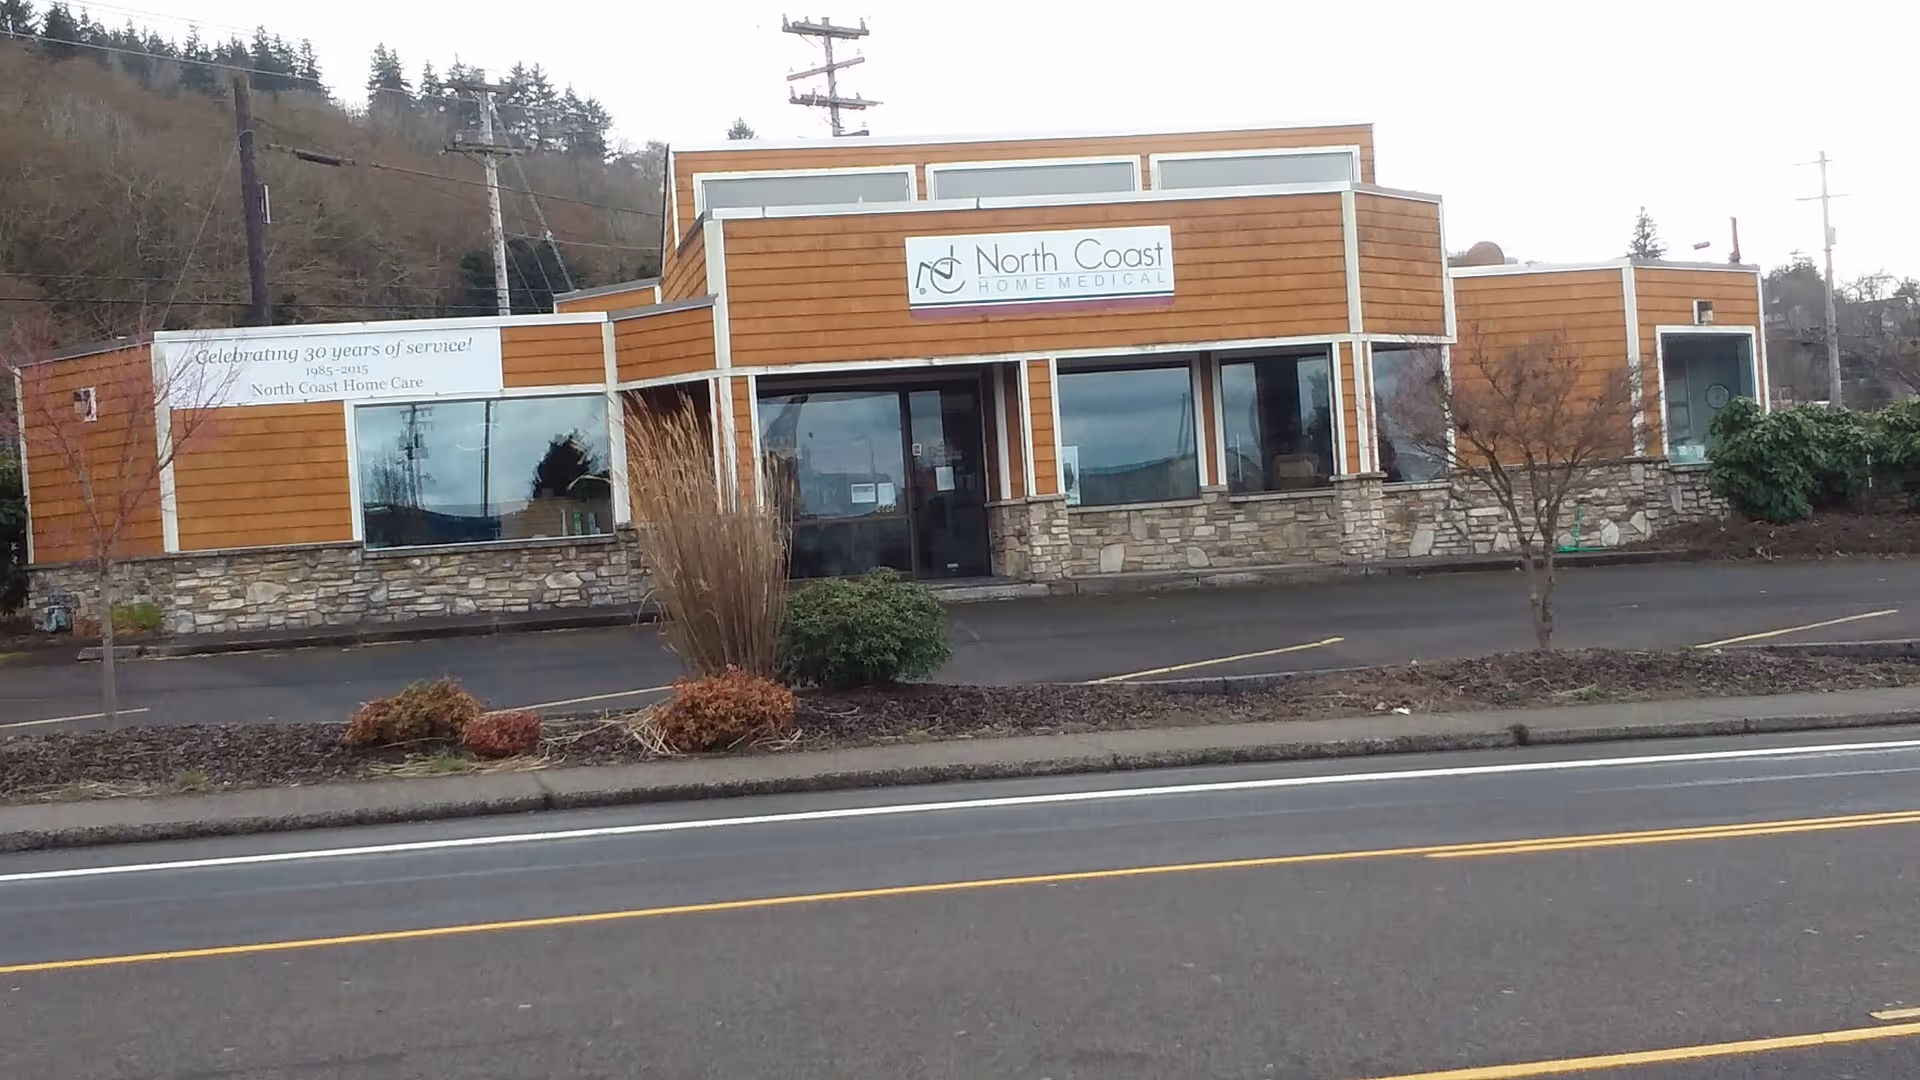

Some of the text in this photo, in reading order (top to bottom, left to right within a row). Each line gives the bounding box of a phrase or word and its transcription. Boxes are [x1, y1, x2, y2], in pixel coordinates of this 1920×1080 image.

[976, 238, 1164, 275] North Coast
[978, 272, 1166, 293] HOME MEDICAL
[195, 336, 473, 365] Celebrating 30 years of service!
[251, 376, 425, 397] North Coast Home Care
